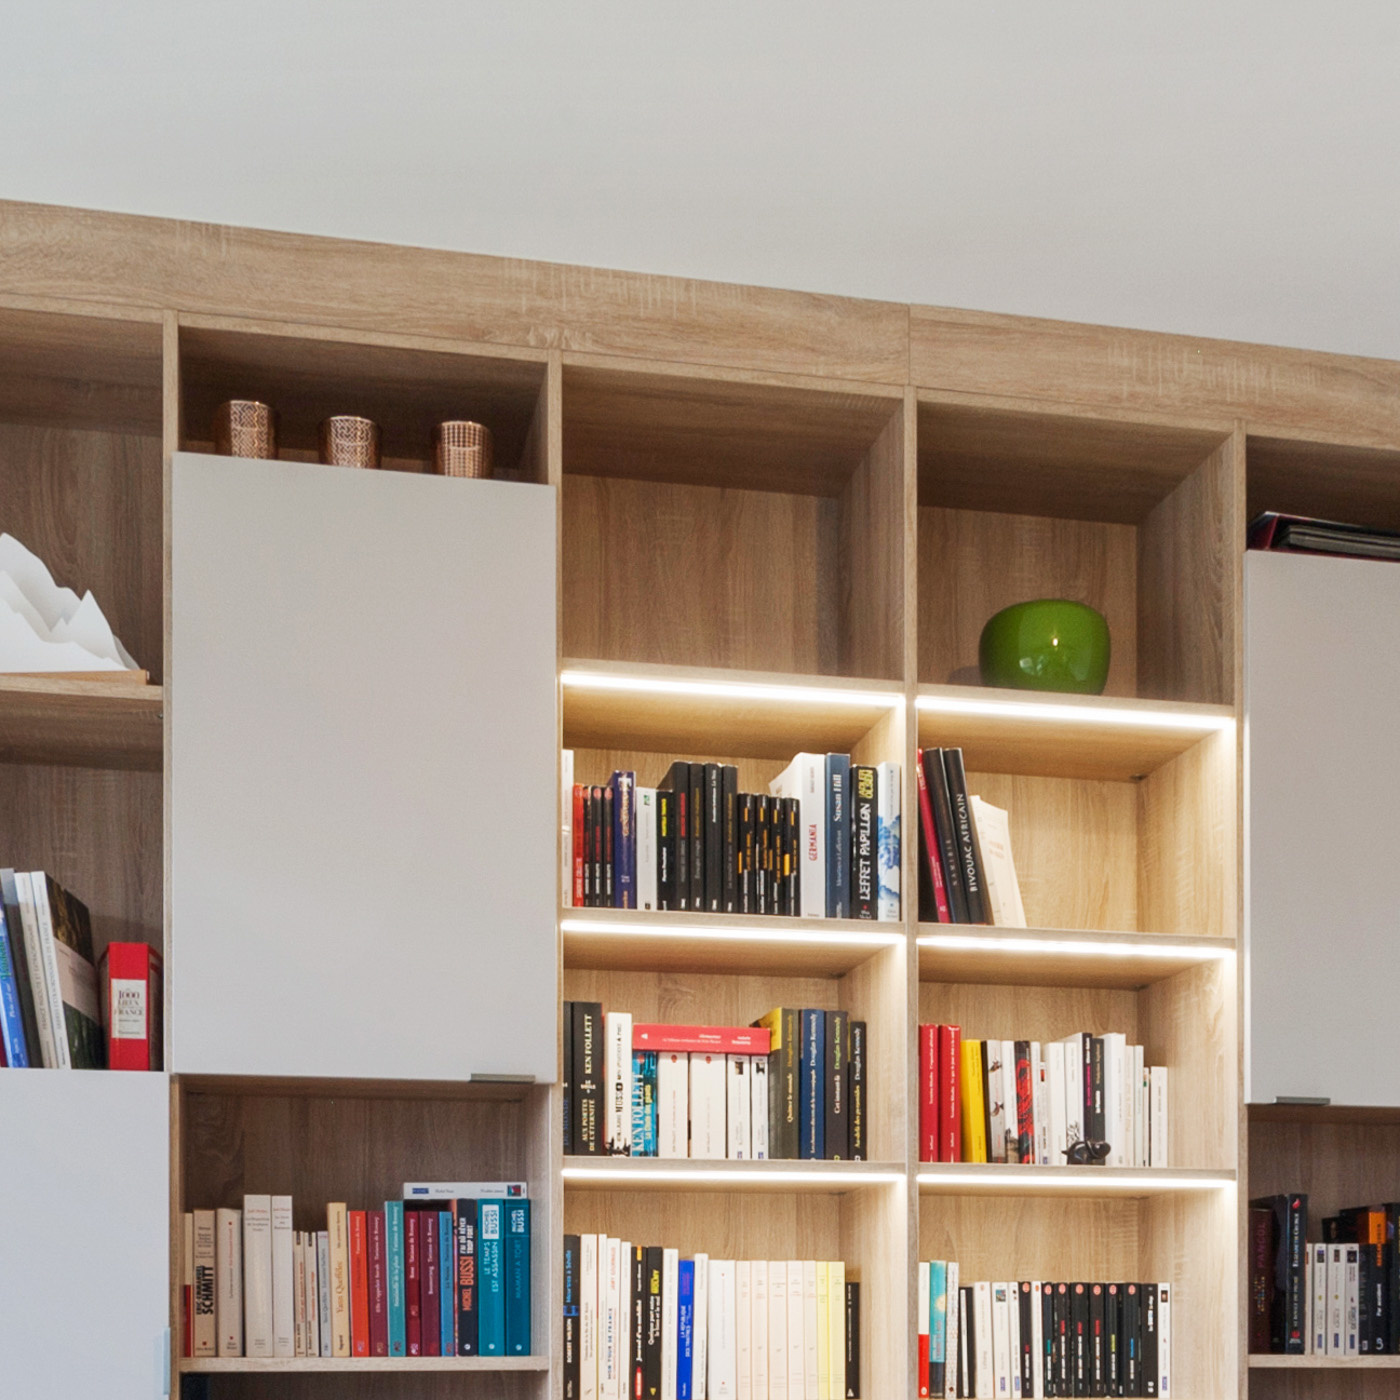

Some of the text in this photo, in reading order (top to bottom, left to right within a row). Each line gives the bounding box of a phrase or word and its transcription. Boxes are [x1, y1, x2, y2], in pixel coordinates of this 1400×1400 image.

[834, 794, 842, 822] Susan
[808, 824, 817, 861] GERMANIA
[957, 793, 978, 892] BIVOUAC AFRICAIN
[584, 1014, 592, 1074] KEN FOLLETT
[632, 1073, 644, 1151] KEN FOLLETT
[517, 1209, 525, 1232] BUSSI
[460, 1256, 474, 1285] BUSSI
[483, 1267, 490, 1275] LE
[491, 1241, 499, 1292] EST ASSASSIN
[203, 1265, 214, 1315] SCHMITT
